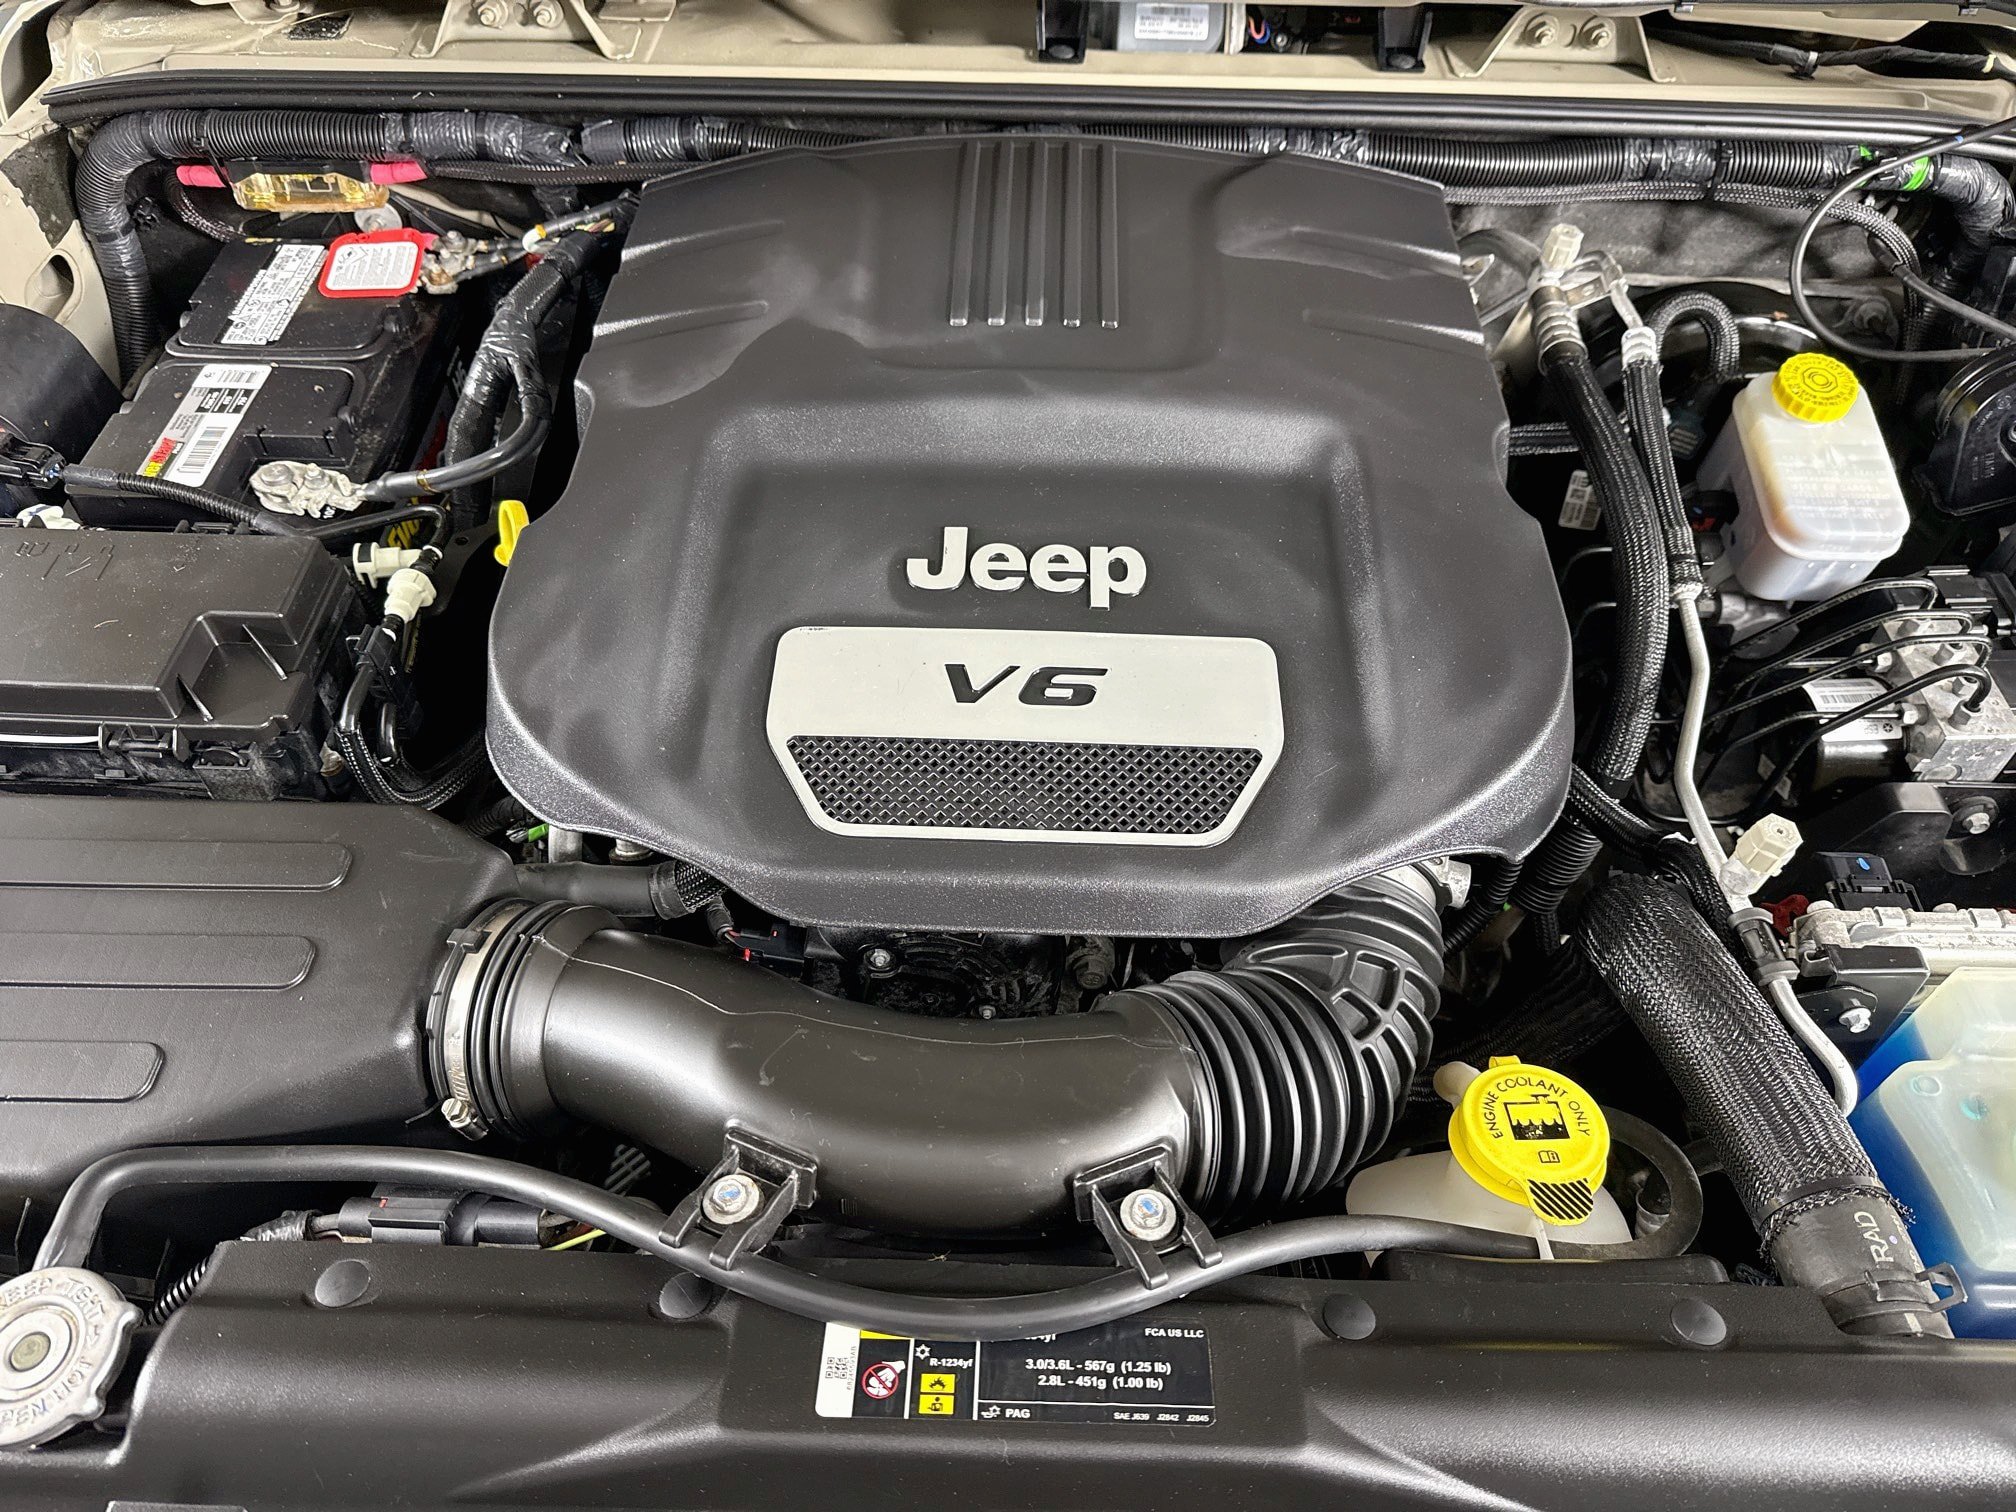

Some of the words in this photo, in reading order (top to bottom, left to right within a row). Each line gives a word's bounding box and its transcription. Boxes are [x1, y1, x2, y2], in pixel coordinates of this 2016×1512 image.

[906, 526, 1147, 611] Jeep
[944, 663, 1112, 706] V6
[1482, 1091, 1504, 1139] ENGINE
[1496, 1076, 1568, 1098] COOLANT
[1568, 1100, 1591, 1137] ONLY
[1854, 1211, 1894, 1262] RAD
[1145, 1328, 1166, 1337] FCA
[1168, 1329, 1182, 1337] US
[1184, 1329, 1205, 1338] LLC
[929, 1358, 974, 1369] R-1234yf
[1025, 1359, 1074, 1370] 3.0/3.6L
[1084, 1360, 1115, 1373] 567g
[1121, 1361, 1151, 1373] (1.25
[1154, 1362, 1172, 1375] lb)
[1037, 1375, 1065, 1386] 2.8L
[1075, 1376, 1106, 1389] 451g
[1112, 1377, 1143, 1389] (1.00
[1146, 1378, 1164, 1391] lb)
[1005, 1408, 1031, 1419] PAG
[1113, 1412, 1130, 1420] SAE
